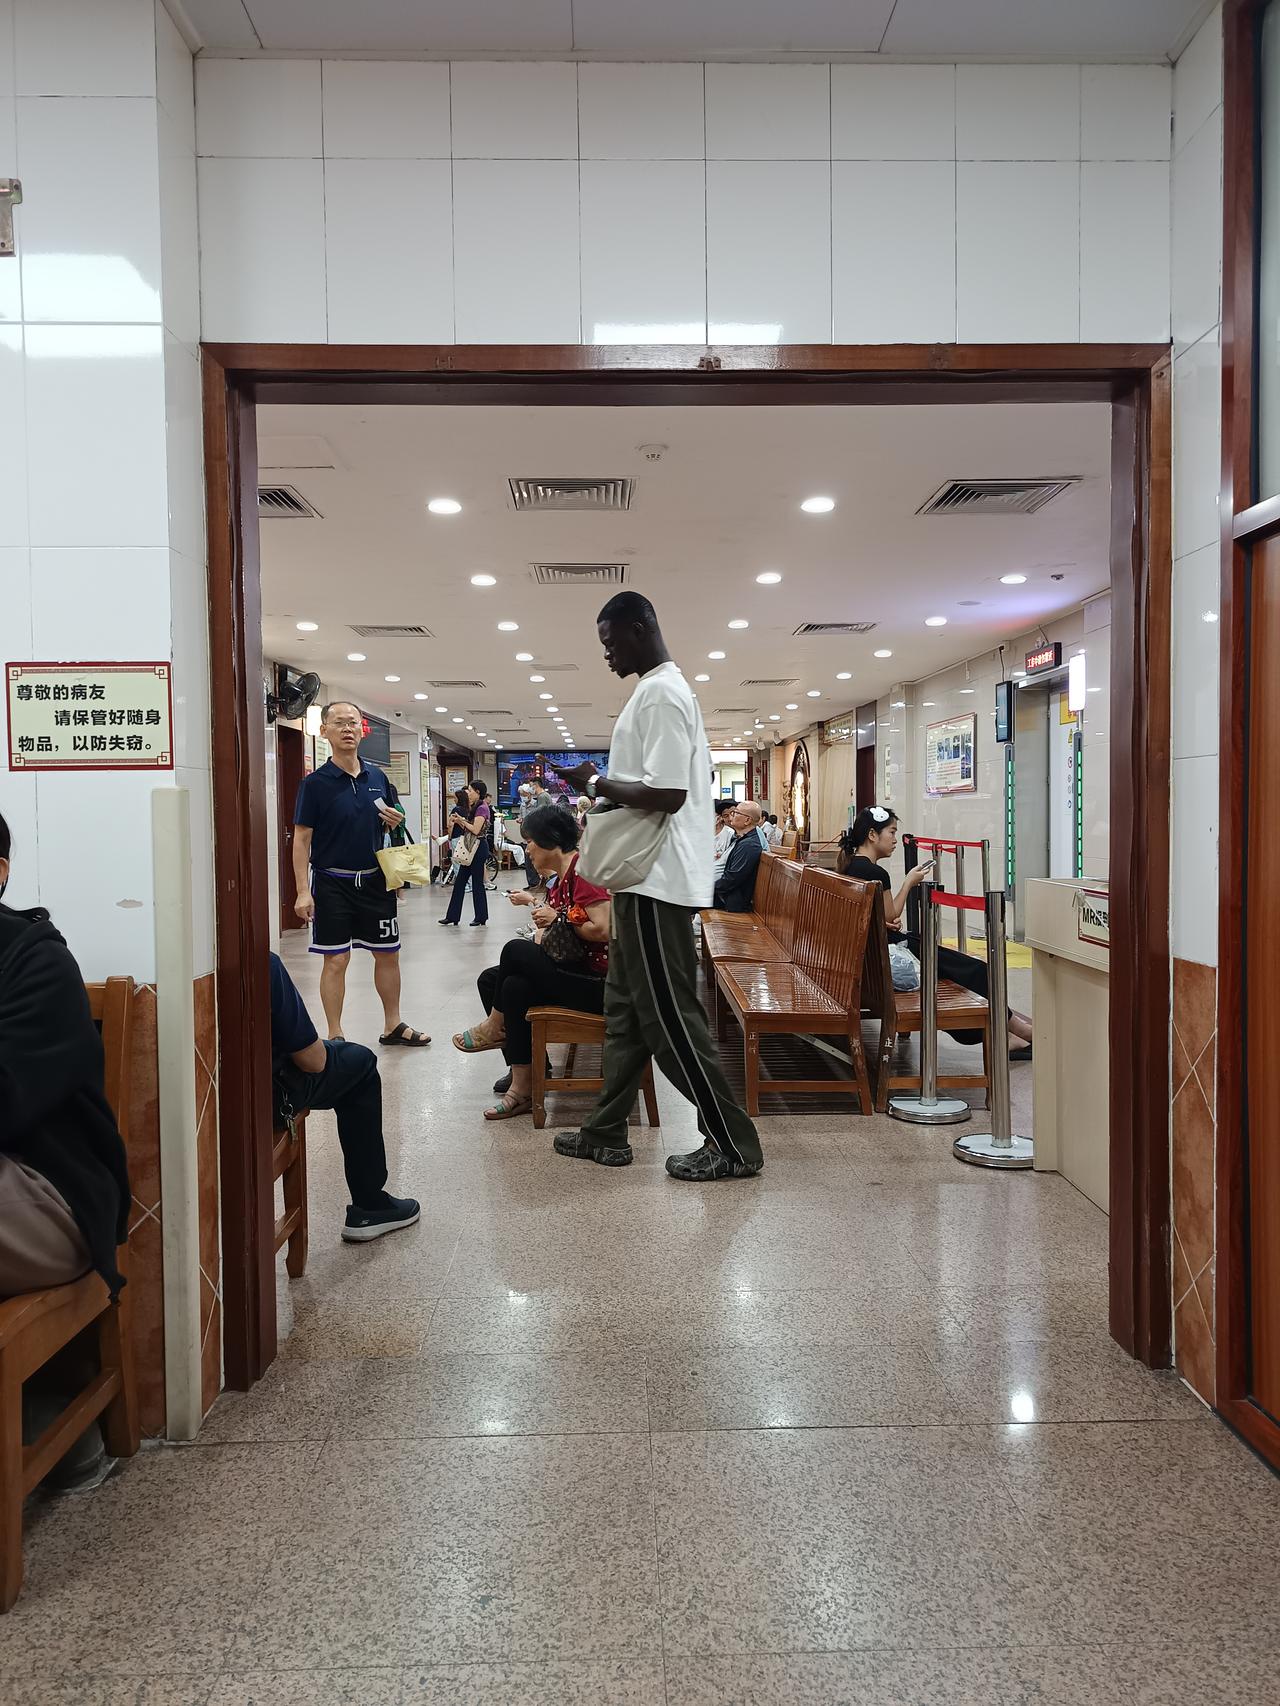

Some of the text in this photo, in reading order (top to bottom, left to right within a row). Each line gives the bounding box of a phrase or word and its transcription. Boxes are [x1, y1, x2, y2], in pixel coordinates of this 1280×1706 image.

[17, 684, 105, 701] 尊敬的病友
[54, 709, 161, 726] 请保管好随身
[18, 735, 152, 752] 物品，以防失窃。
